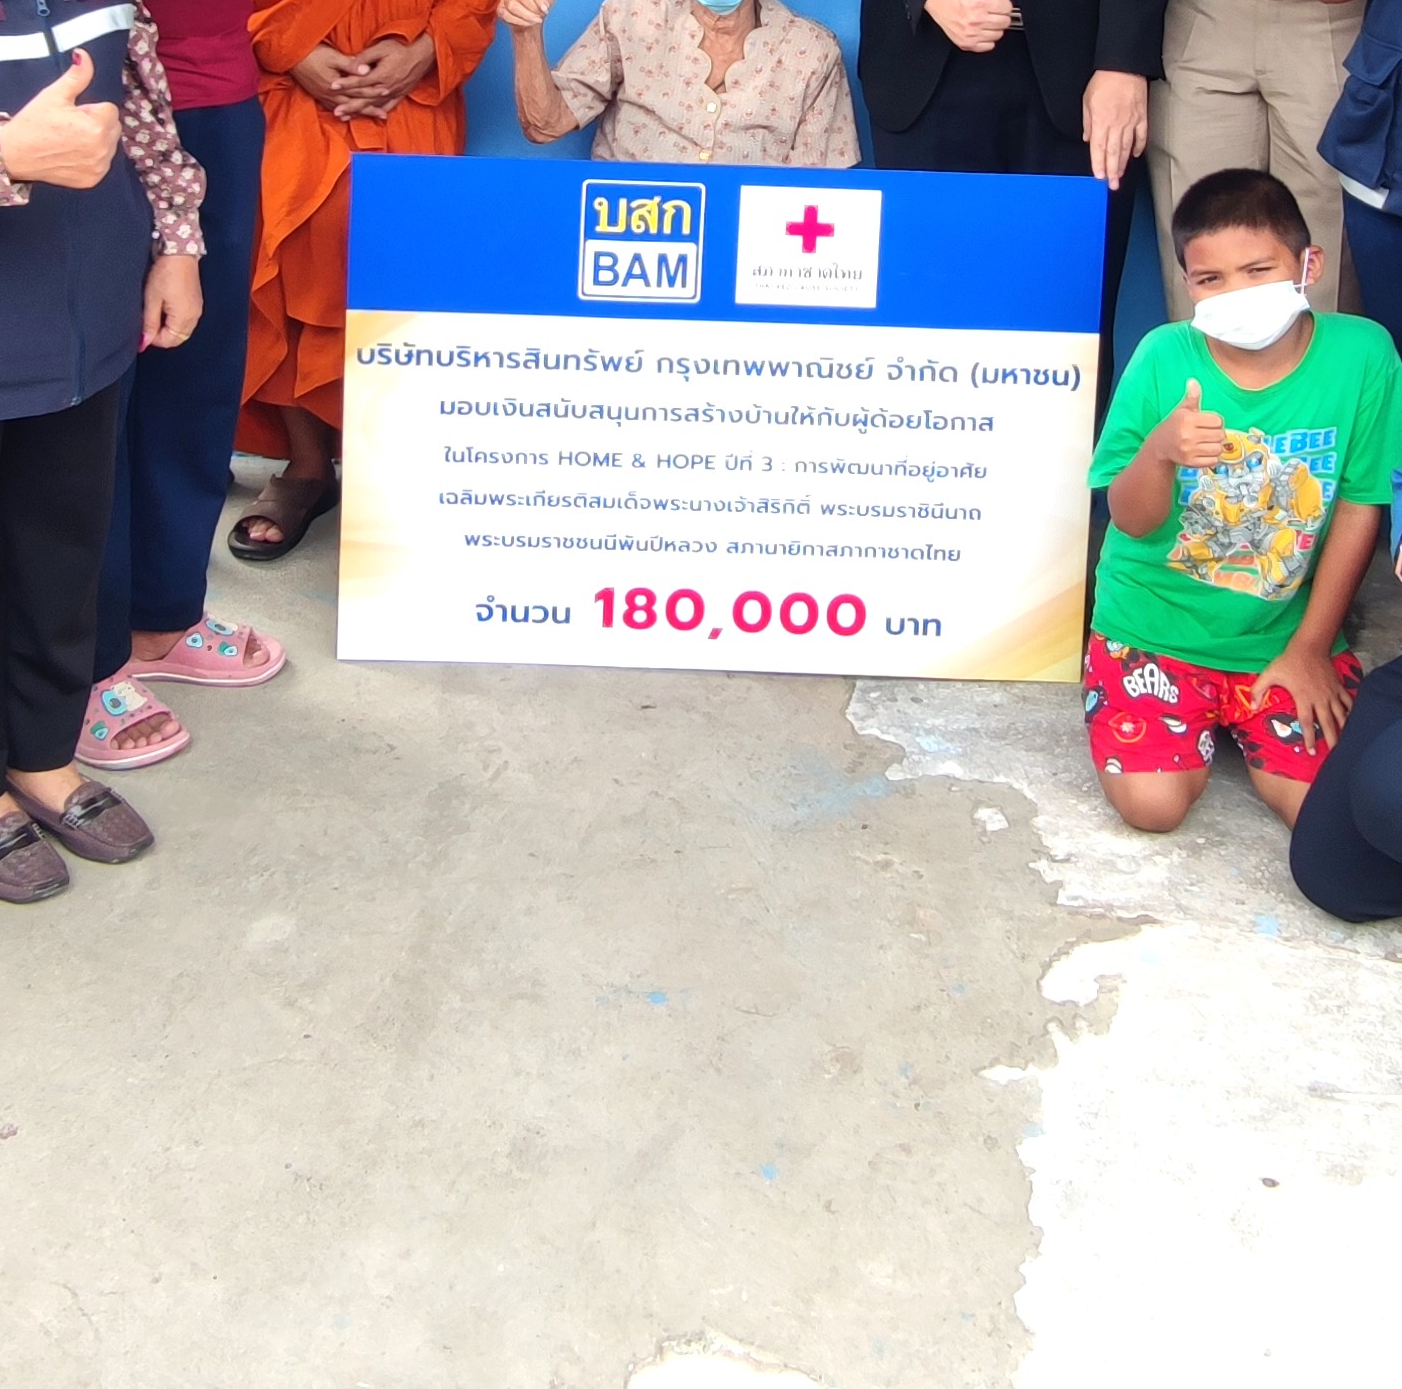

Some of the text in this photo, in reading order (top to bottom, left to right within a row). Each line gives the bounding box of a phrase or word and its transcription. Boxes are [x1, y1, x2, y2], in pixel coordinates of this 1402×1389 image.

[593, 196, 693, 236] บสก
[592, 250, 689, 290] BAM
[356, 342, 1081, 392] บริษัทบริหารสินทรัพย์ กรุงเทพพาณิชย์ จำกัด (มหาชน)
[444, 446, 549, 466] ในโครงการ
[558, 451, 623, 468] HOME
[631, 453, 646, 468] &
[657, 454, 716, 470] HOPE
[725, 451, 753, 472] ปีที่
[761, 457, 773, 472] 3
[795, 456, 987, 483] การพัฒนาที่อยู่อาศัย
[820, 501, 982, 521] พระบรมราชินีนาถ
[464, 533, 961, 562] พระบรมราชชนนีพันปีหลวง สภานายิกาสภากาชาดไทย
[475, 587, 942, 640] จำนวน 180,000 บาท
[1123, 663, 1179, 704] BEARS
